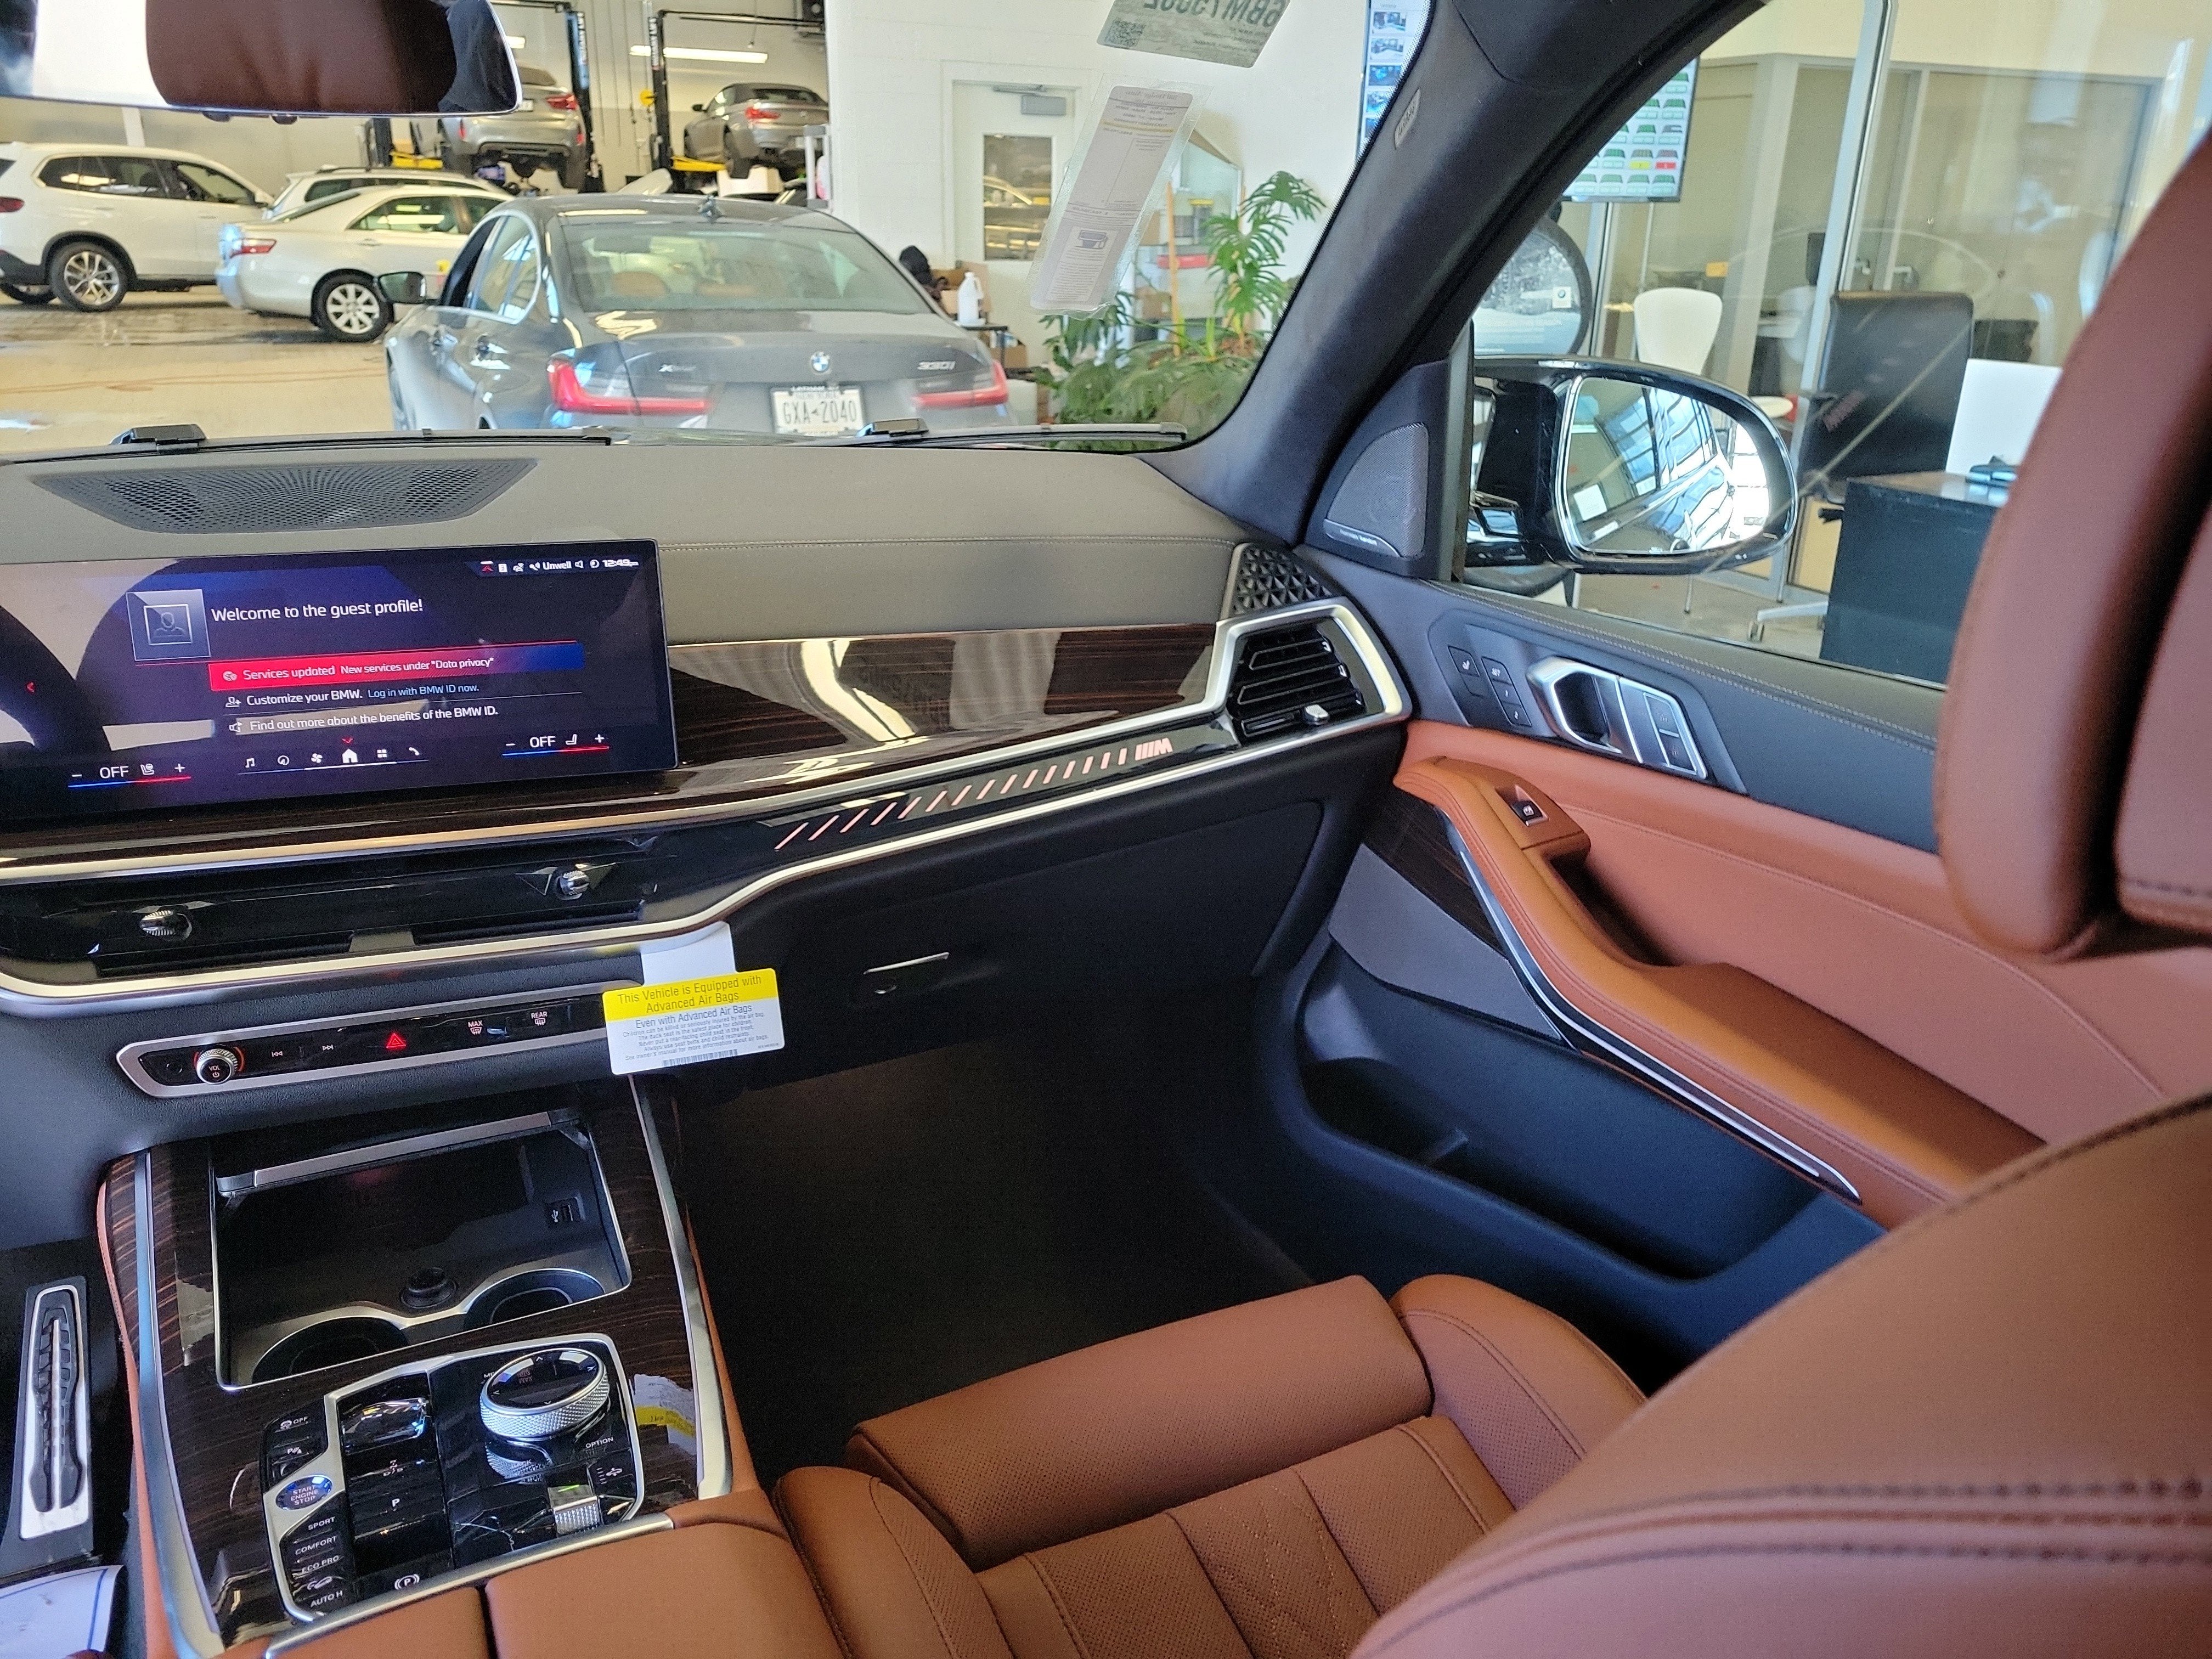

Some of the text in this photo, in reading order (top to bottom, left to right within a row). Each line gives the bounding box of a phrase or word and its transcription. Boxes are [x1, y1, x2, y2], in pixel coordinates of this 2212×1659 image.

[543, 560, 572, 570] Unwell
[211, 599, 424, 622] Welcome to the guest profile!
[243, 669, 290, 680] Services
[291, 665, 336, 679] updated
[340, 665, 363, 675] New
[364, 663, 402, 673] services
[403, 661, 431, 672] under
[246, 684, 480, 706] Customize your BMW. Log in with BMW ID now.
[250, 706, 499, 731] Find out more about the benefits of the BMW ID.
[530, 736, 556, 748] OFF
[99, 765, 129, 779] OFF
[617, 975, 761, 1005] This Vehicle is Equipped with
[646, 991, 740, 1013] Advanced Air Bags
[635, 1005, 753, 1029] Even with Advanced Air Bags
[292, 1416, 308, 1424] OFF
[585, 1436, 614, 1448] OPTION
[290, 1489, 319, 1502] ENGINE
[292, 1485, 316, 1495] START
[294, 1496, 315, 1506] STOP
[391, 1498, 400, 1508] P
[308, 1516, 336, 1531] SPORT
[295, 1536, 337, 1556] COMFORT
[302, 1555, 340, 1573] ECO PRO
[310, 1593, 335, 1608] AUTO
